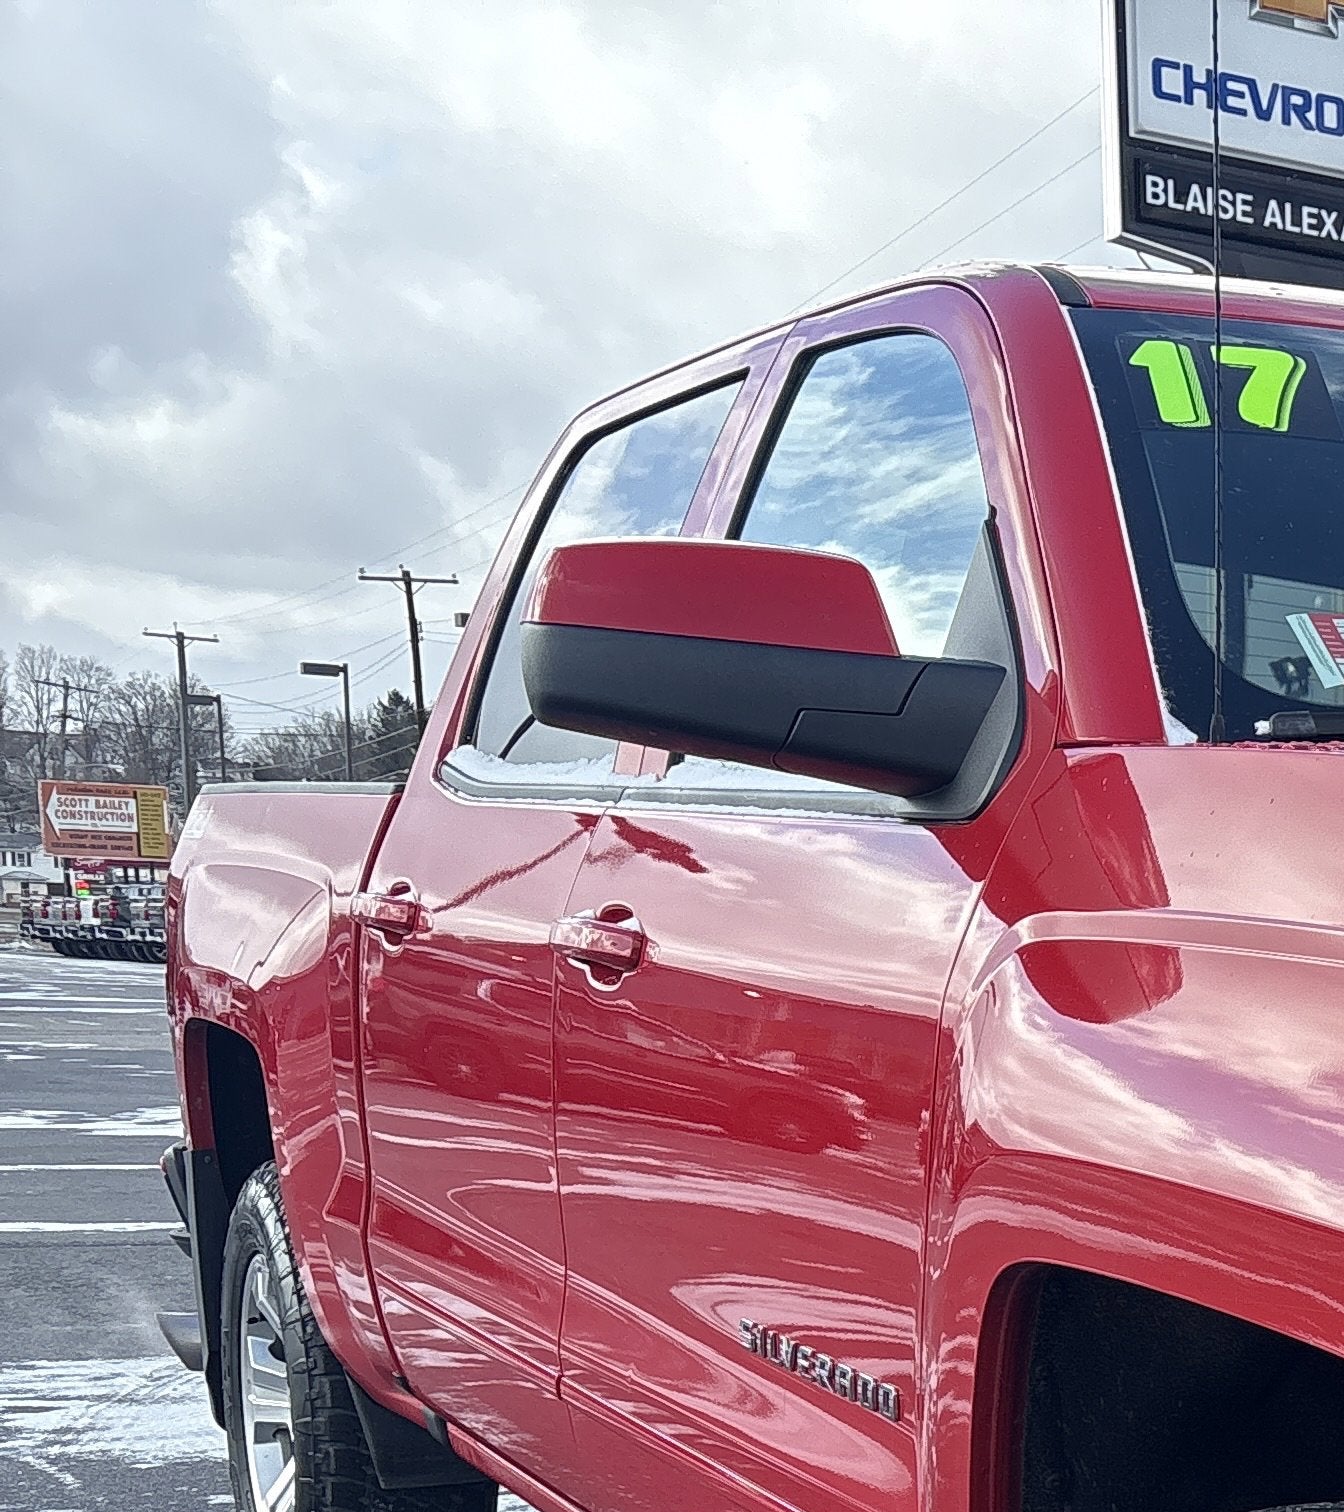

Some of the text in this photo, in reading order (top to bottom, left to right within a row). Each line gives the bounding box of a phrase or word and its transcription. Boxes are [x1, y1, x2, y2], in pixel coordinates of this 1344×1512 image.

[1144, 174, 1255, 224] BLAISE
[1128, 340, 1307, 432] 17
[54, 809, 135, 823] CONSTRUCTION
[56, 797, 130, 811] SCOTT BAILEY
[738, 1317, 902, 1423] SILVERADO
